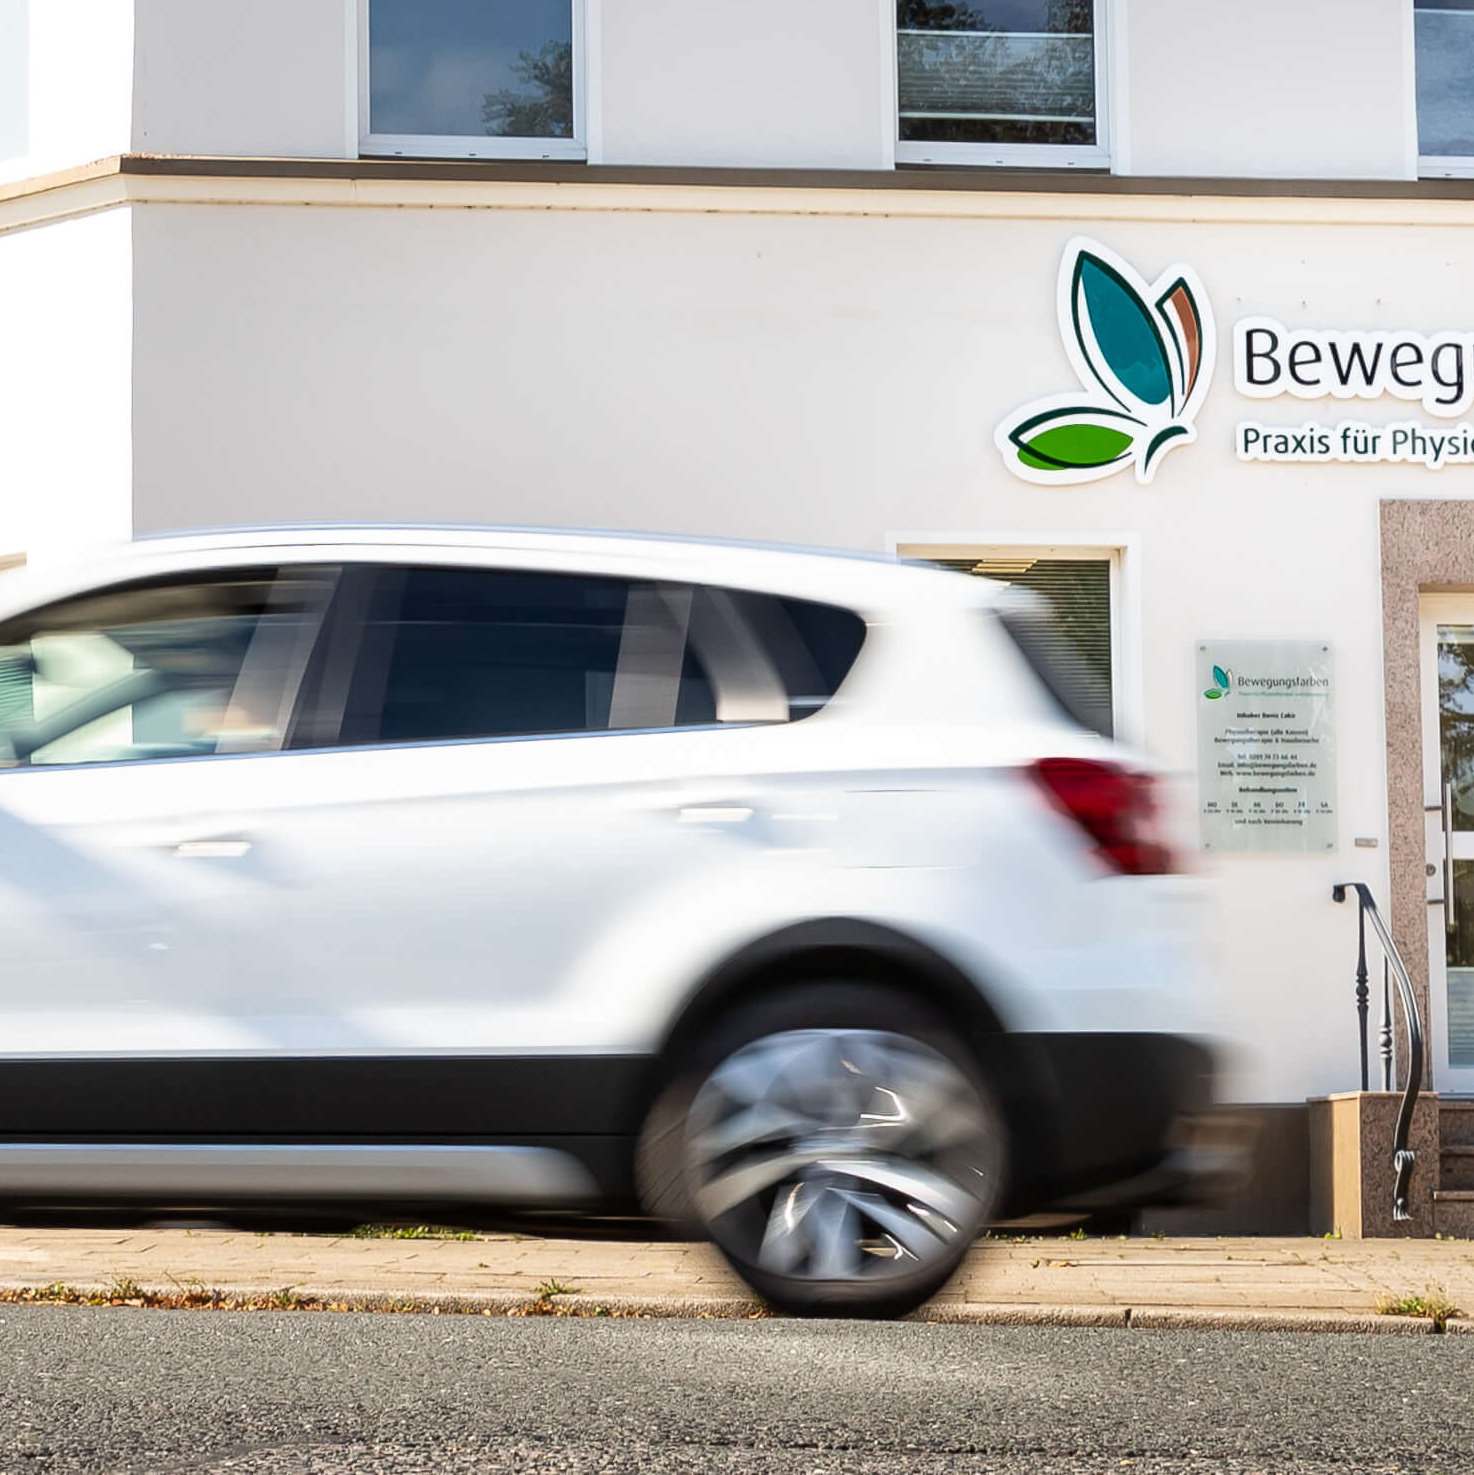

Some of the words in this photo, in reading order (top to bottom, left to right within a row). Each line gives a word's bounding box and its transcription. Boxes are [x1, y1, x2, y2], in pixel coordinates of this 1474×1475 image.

[1244, 428, 1330, 455] Praxis
[1341, 427, 1380, 455] für
[1237, 676, 1329, 689] Bewegungsfarben
